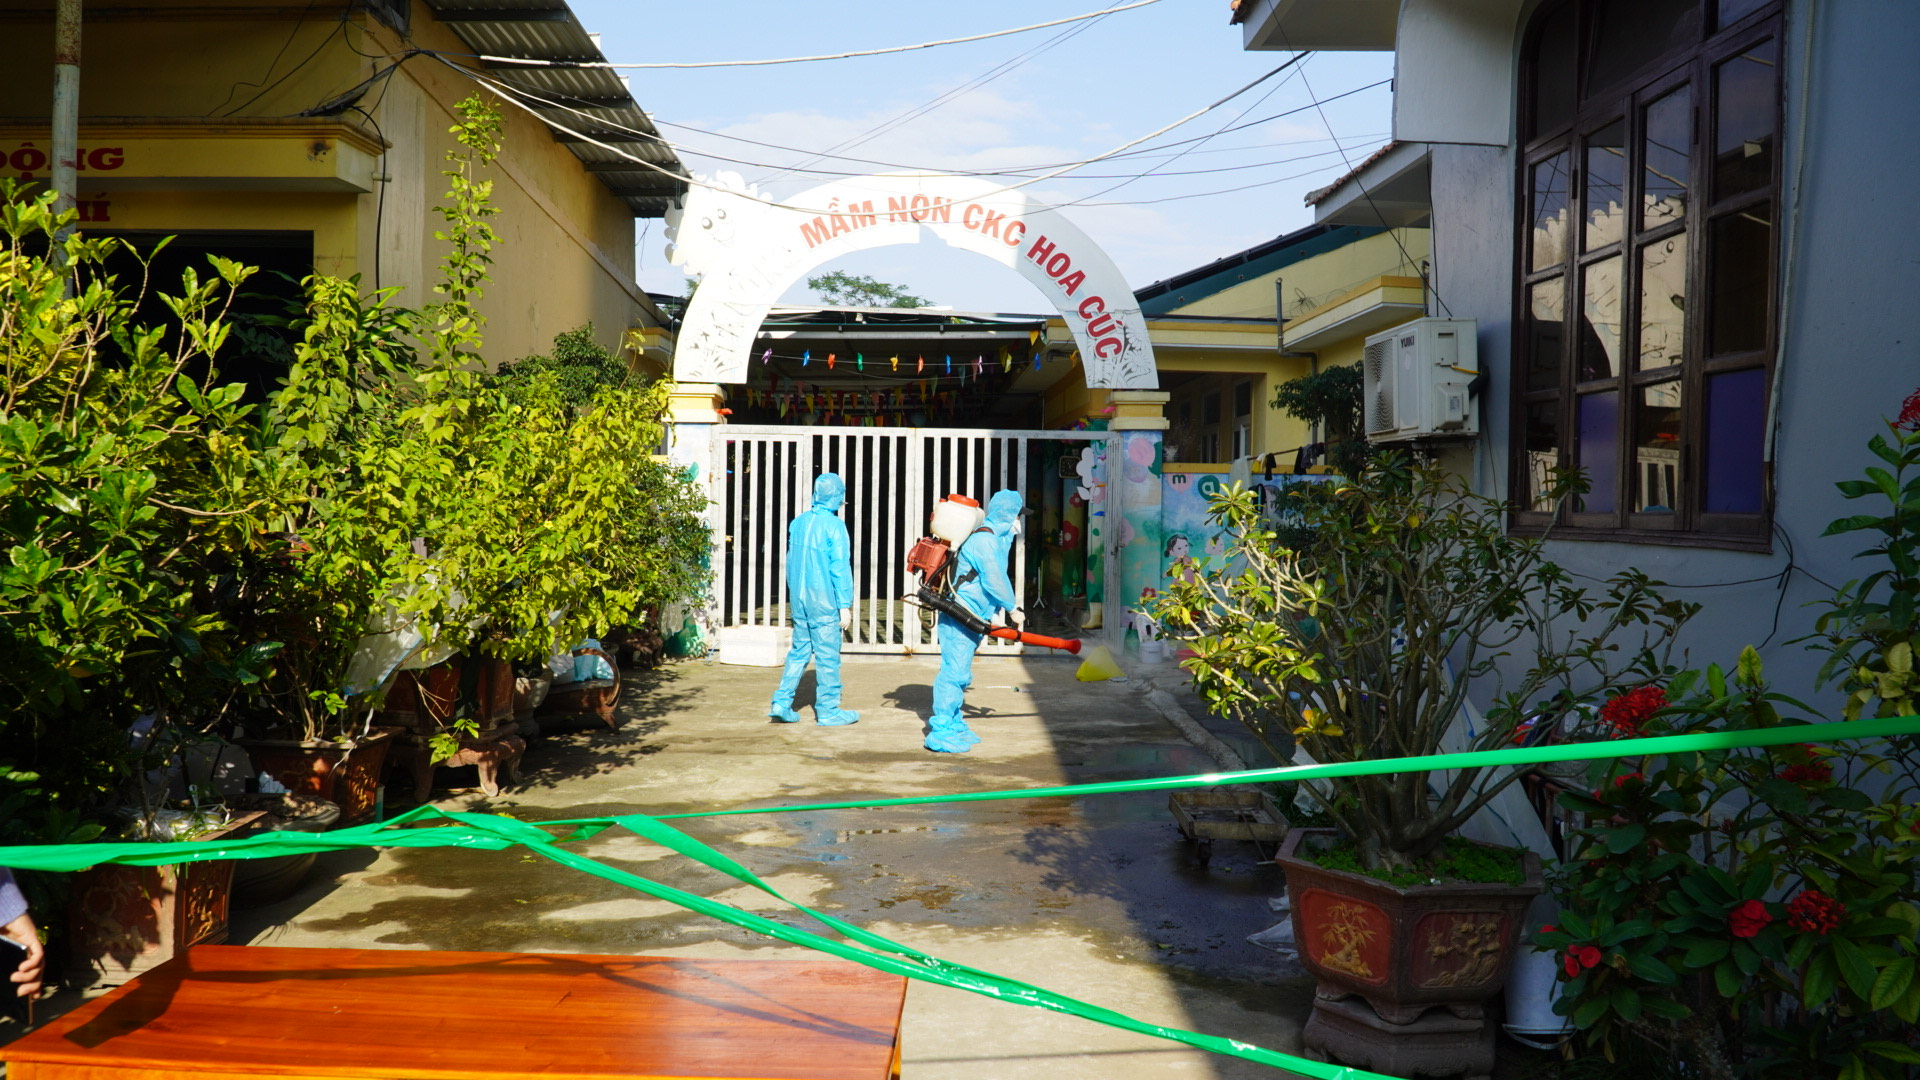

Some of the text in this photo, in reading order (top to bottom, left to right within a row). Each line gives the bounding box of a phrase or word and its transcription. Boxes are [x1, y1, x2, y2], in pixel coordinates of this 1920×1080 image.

[0, 142, 125, 181] ỘG
[799, 193, 1125, 359] MẦM NON CKC HOA CÚC
